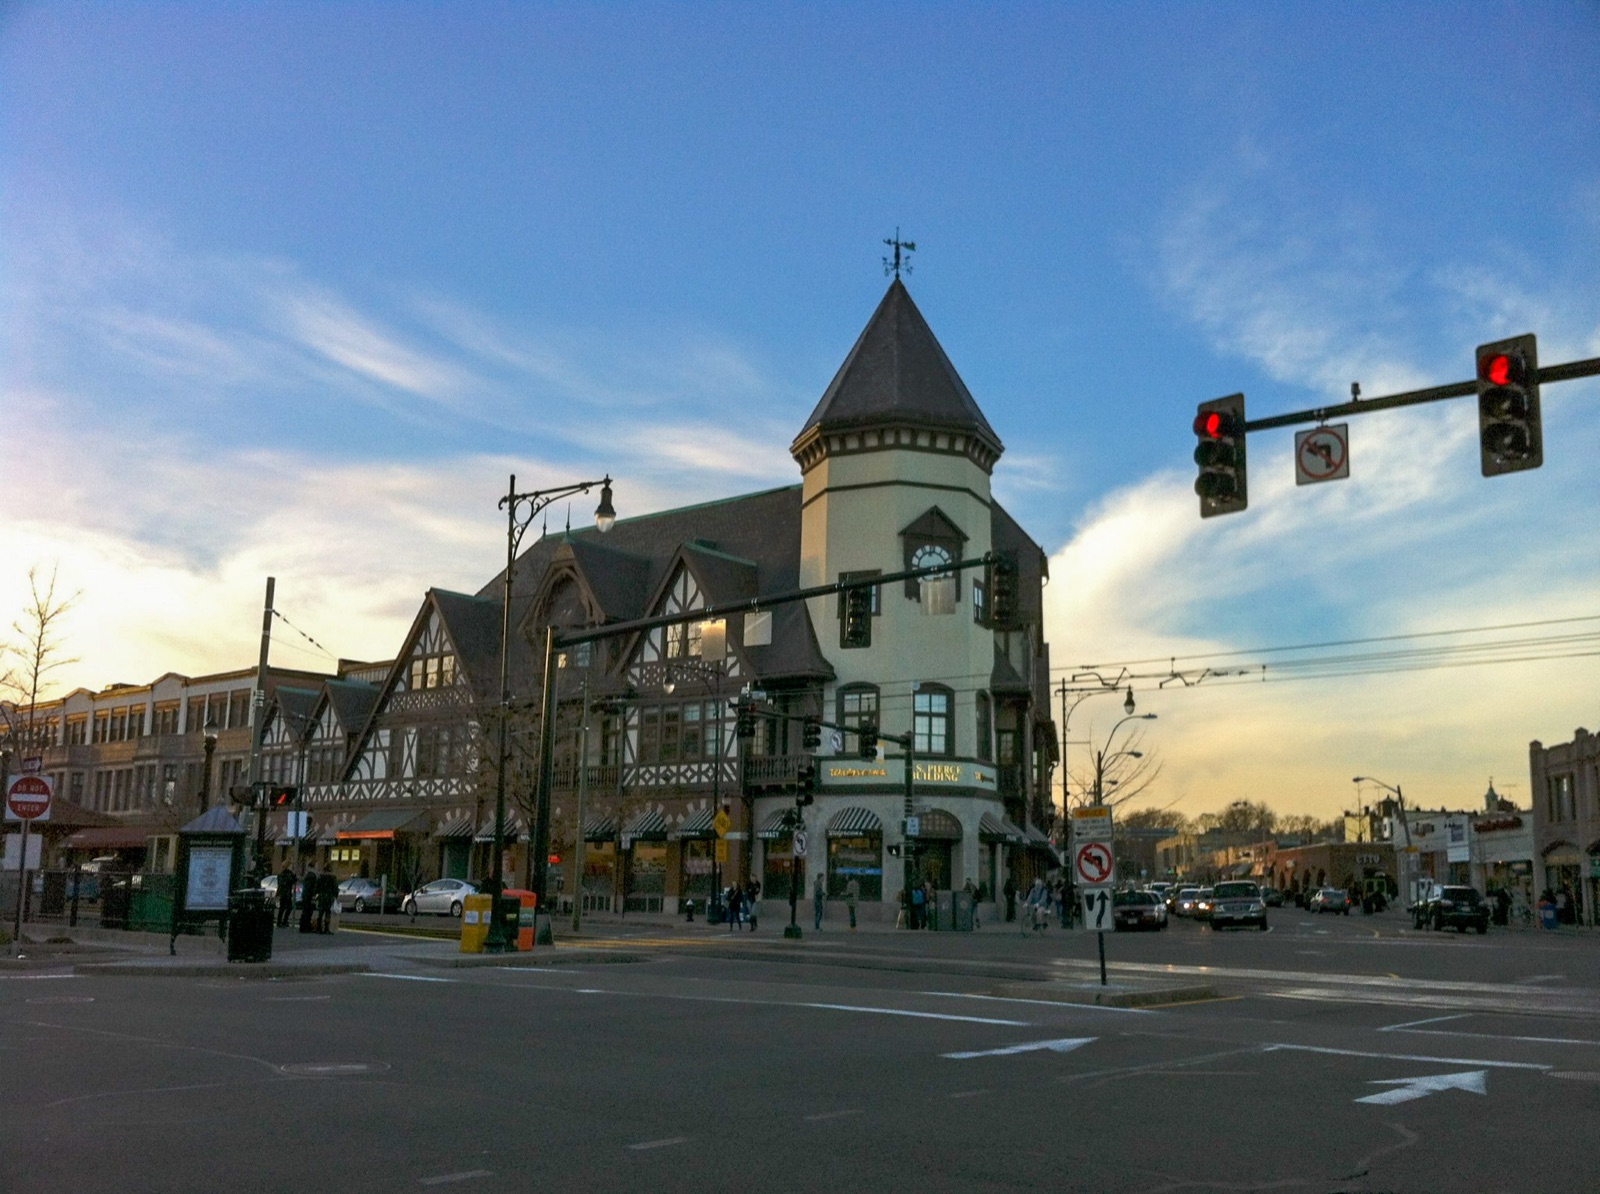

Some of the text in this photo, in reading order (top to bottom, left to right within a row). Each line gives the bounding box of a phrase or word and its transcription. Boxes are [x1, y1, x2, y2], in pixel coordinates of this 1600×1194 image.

[928, 764, 962, 774] PIERCE
[17, 784, 44, 793] DO NOT
[17, 803, 39, 812] ENTER
